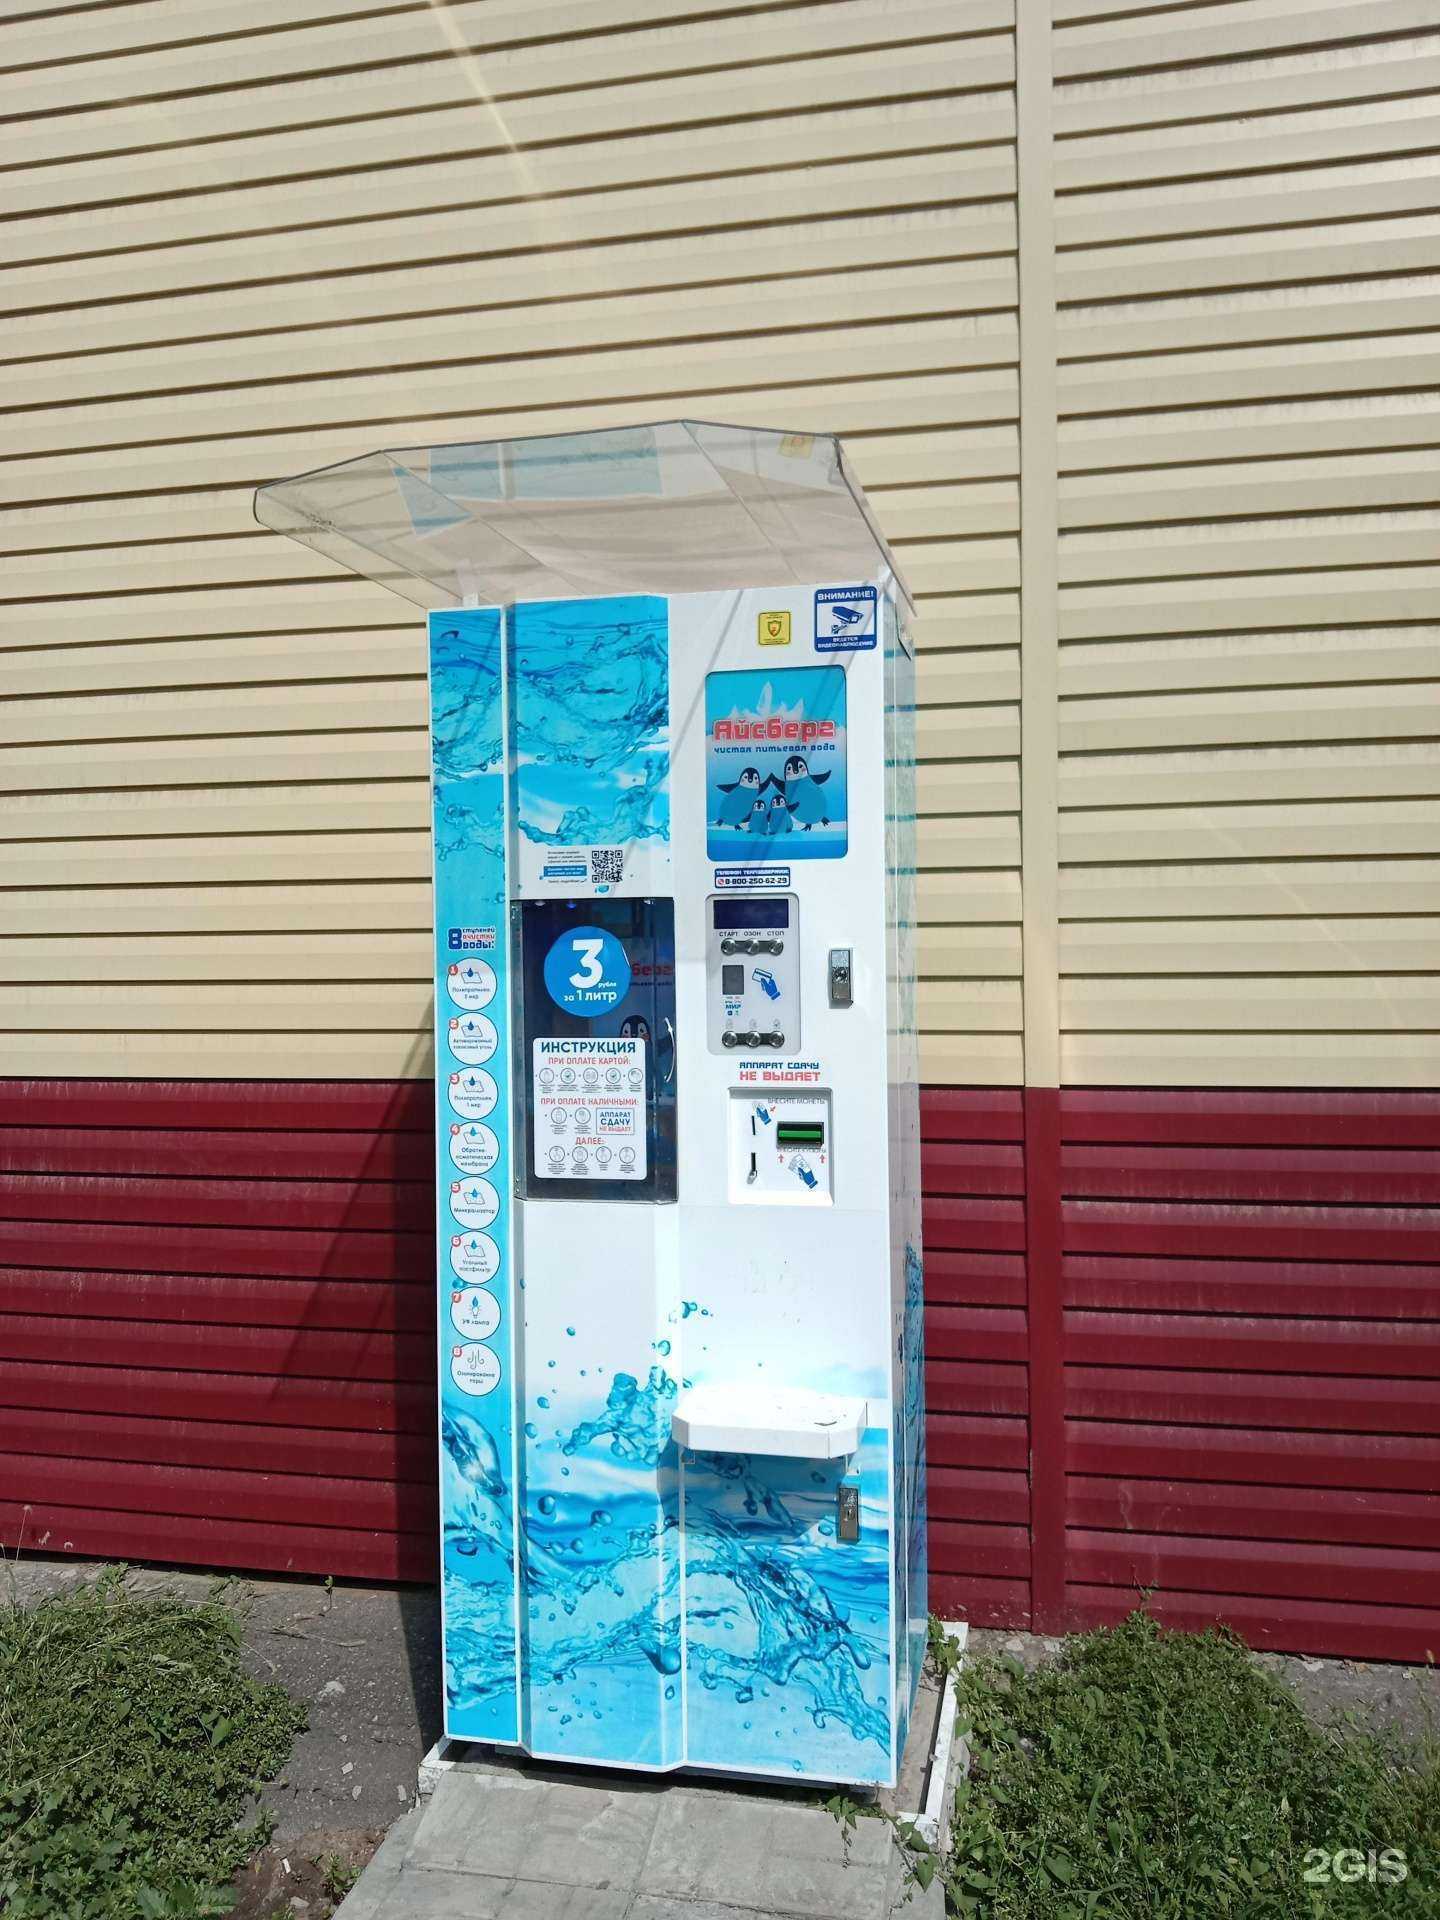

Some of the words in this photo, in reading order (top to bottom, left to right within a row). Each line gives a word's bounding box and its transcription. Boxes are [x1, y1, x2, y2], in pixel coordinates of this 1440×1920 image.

[817, 590, 874, 601] ВНИМАНИЕ!
[713, 717, 836, 743] Айсберг
[714, 746, 752, 754] чистая
[756, 746, 807, 754] питьевая
[811, 743, 835, 752] вода
[448, 927, 462, 950] 8
[569, 938, 604, 989] 3
[576, 990, 582, 1000] 1
[585, 992, 617, 1003] литр
[541, 1041, 636, 1054] ИНСТРУКЦИЯ
[548, 1057, 564, 1065] ПРИ
[566, 1057, 596, 1065] ОПЛАТЕ
[739, 1061, 784, 1070] АППАРАТ
[787, 1061, 820, 1070] СДАЧУ
[739, 1071, 757, 1081] НЕ
[763, 1071, 821, 1081] ВЫДАЕТ
[601, 1118, 630, 1126] СДАЧУ
